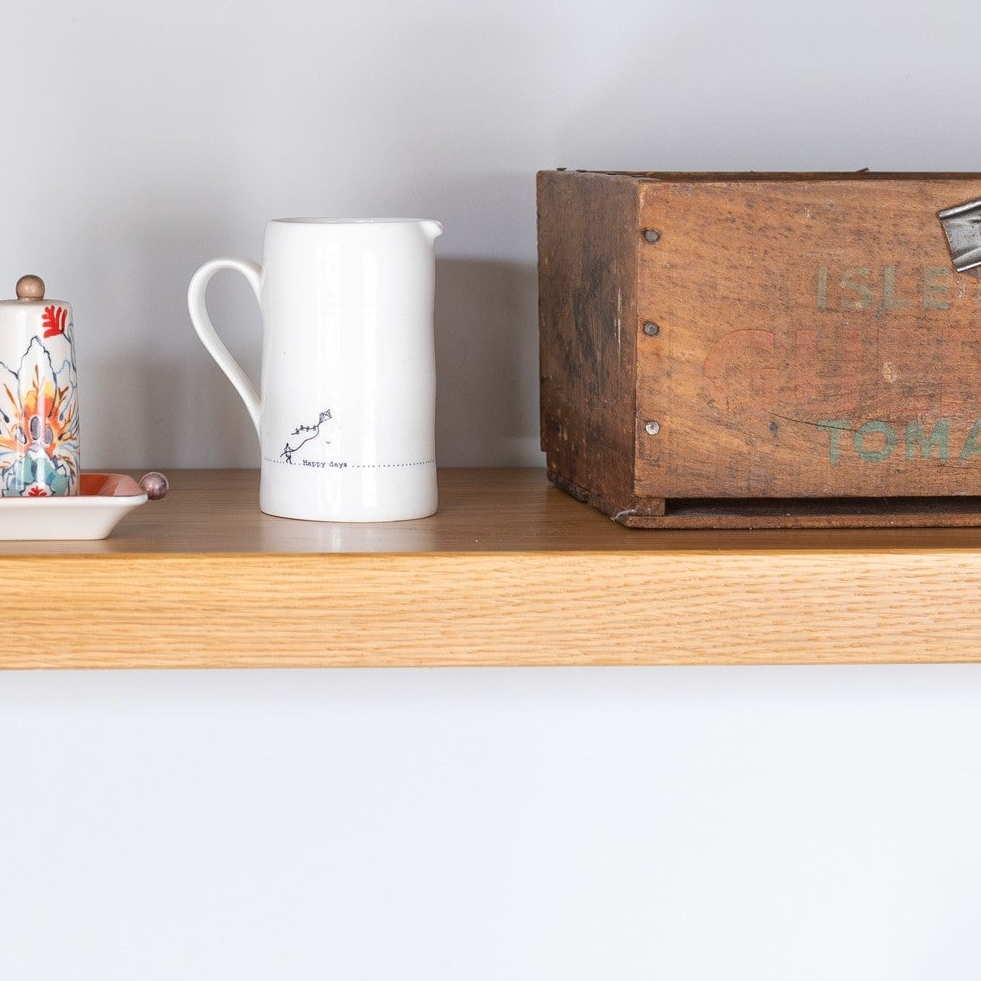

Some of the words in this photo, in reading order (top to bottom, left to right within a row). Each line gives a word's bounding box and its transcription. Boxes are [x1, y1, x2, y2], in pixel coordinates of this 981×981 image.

[817, 265, 953, 312] ISLE
[302, 459, 326, 469] Happy
[328, 460, 348, 469] days
